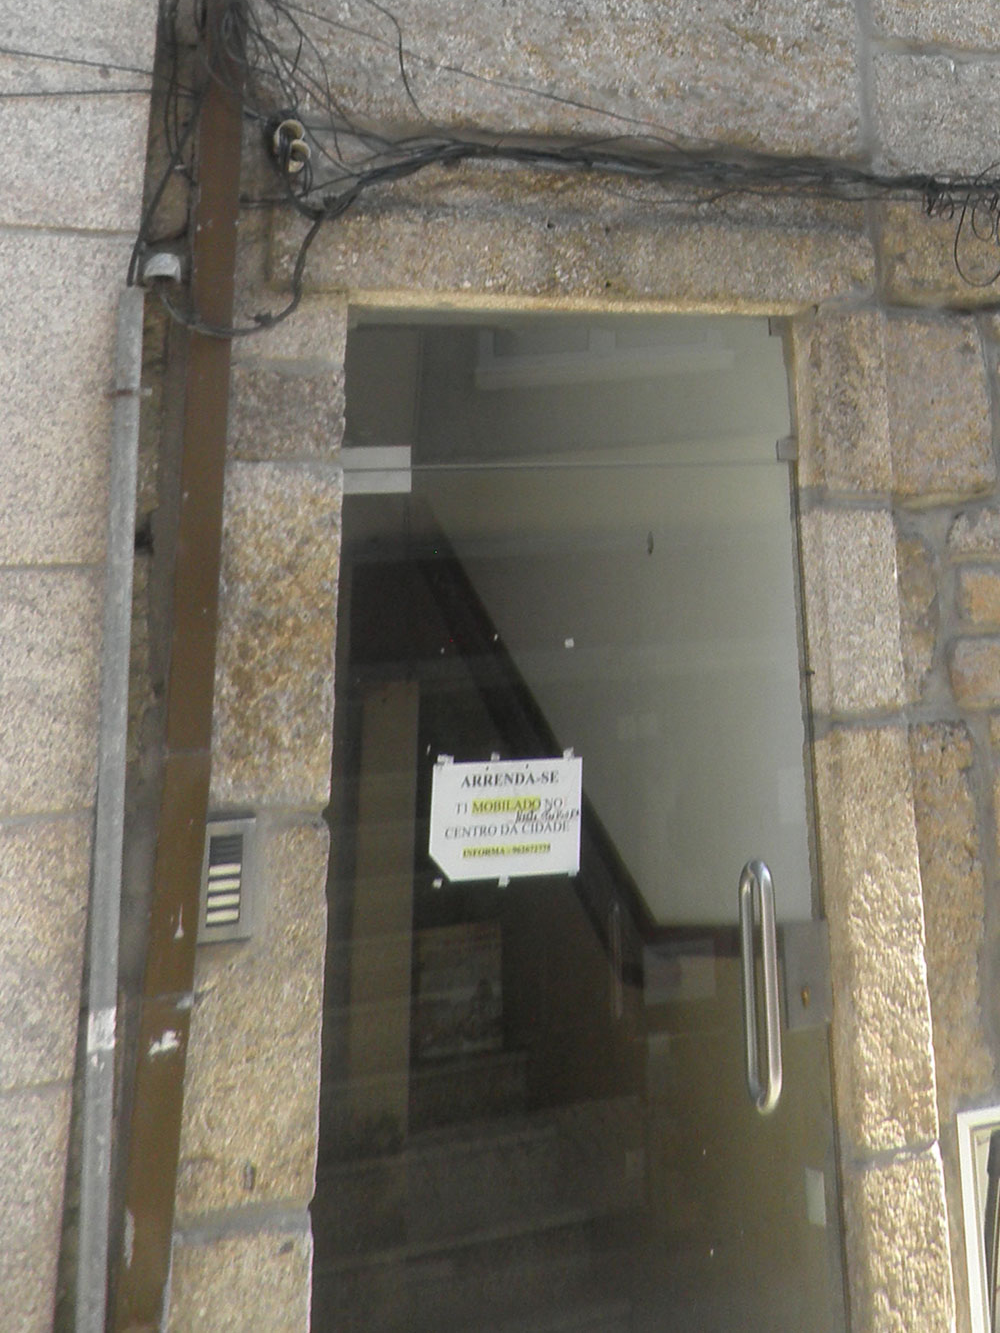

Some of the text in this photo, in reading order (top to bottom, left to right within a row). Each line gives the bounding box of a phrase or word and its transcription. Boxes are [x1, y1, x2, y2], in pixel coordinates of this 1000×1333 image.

[461, 770, 559, 789] ARRENDA-SE
[472, 796, 541, 814] MOBILADO
[544, 797, 563, 811] NO
[444, 820, 571, 840] CENTRO DA CIDADE
